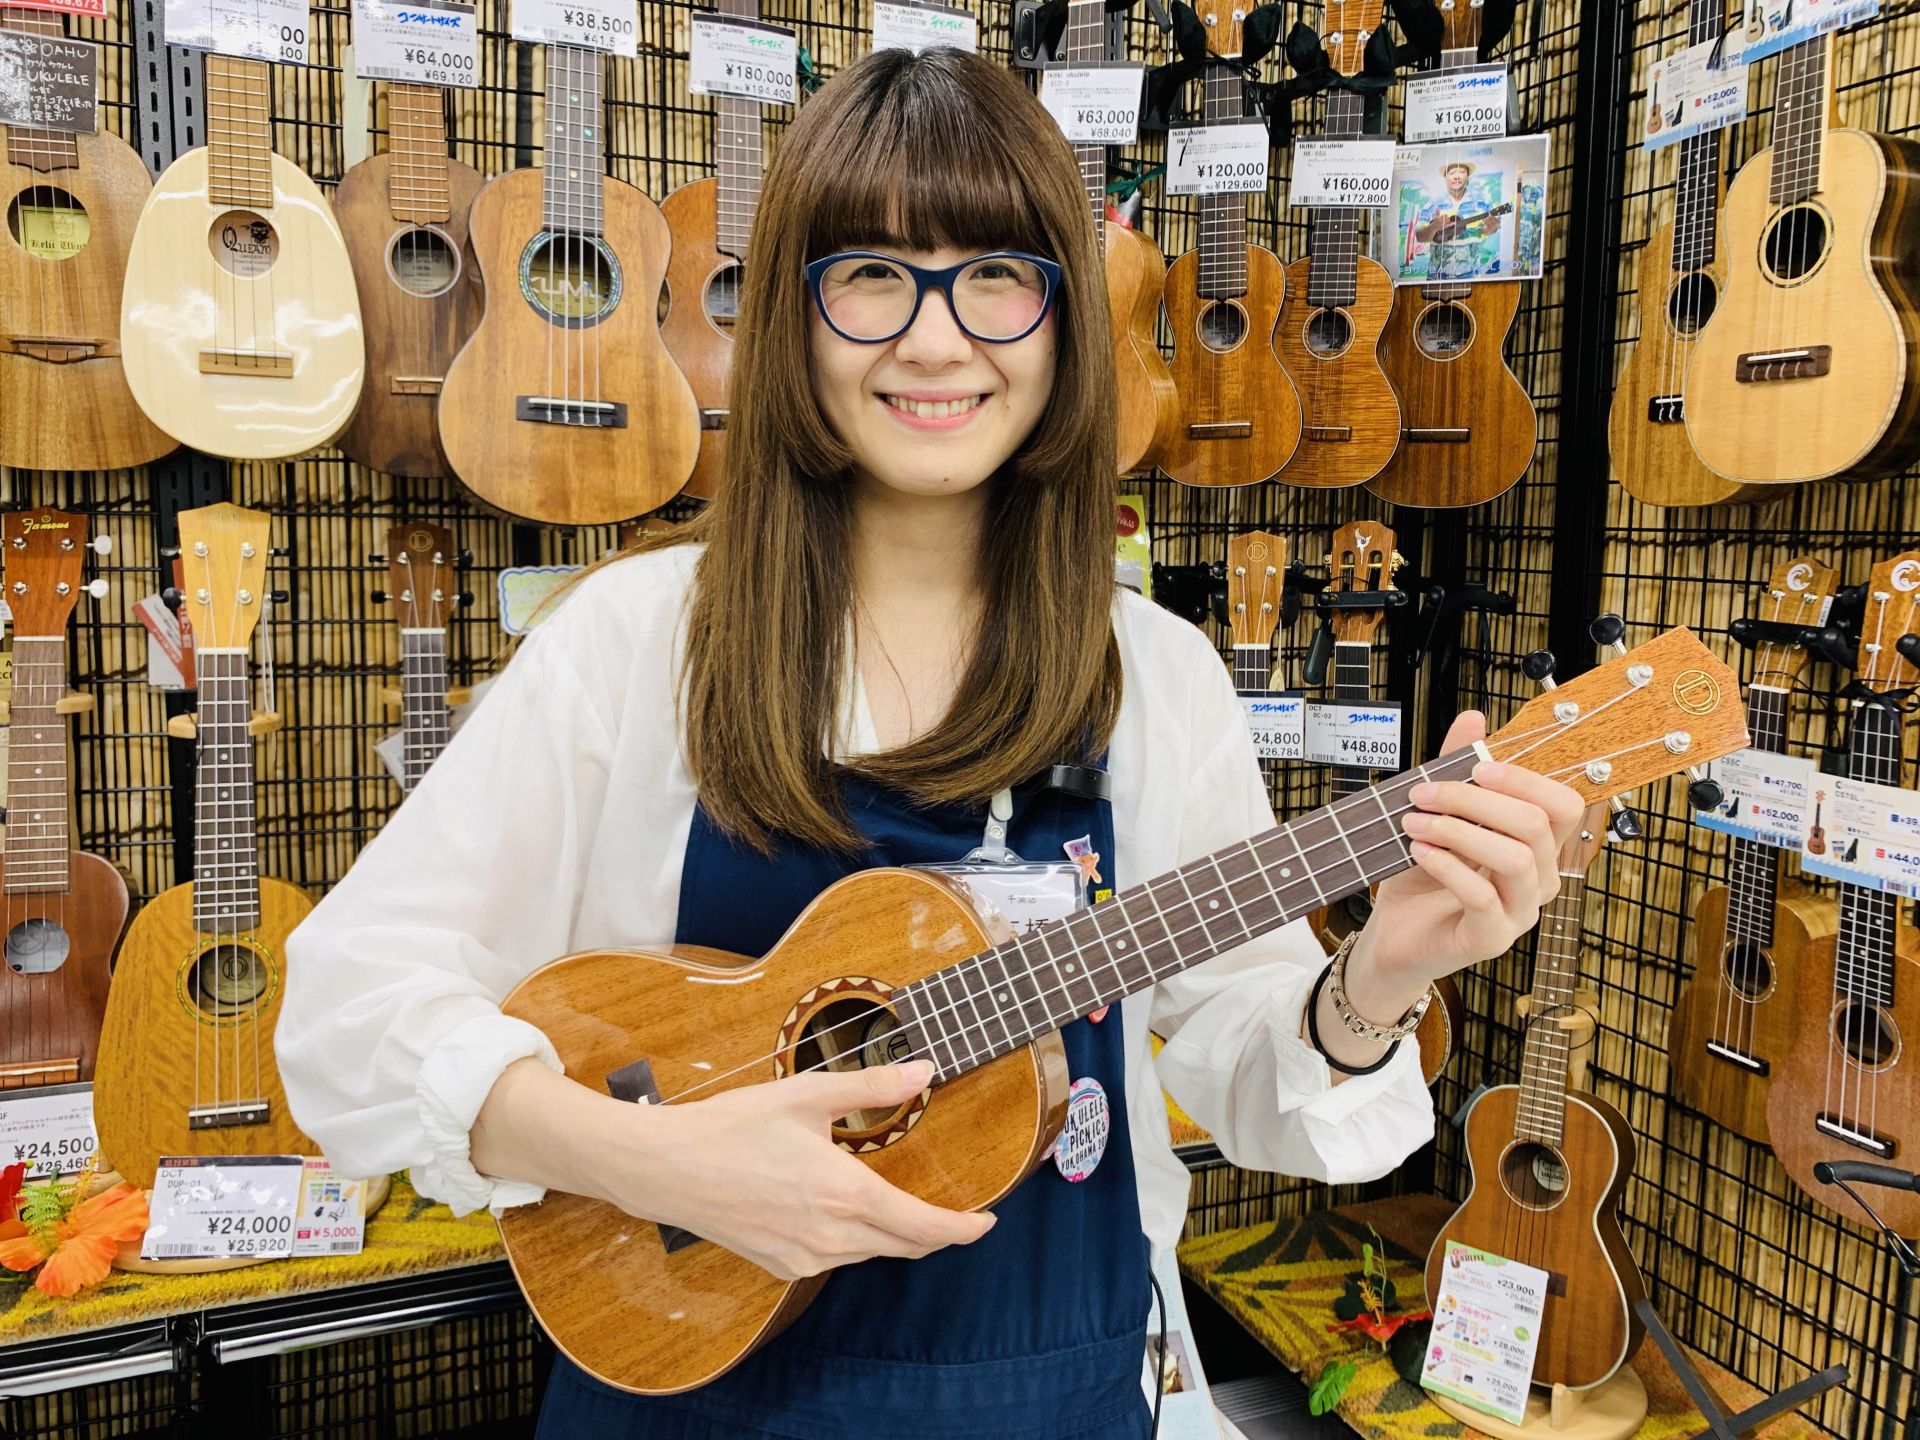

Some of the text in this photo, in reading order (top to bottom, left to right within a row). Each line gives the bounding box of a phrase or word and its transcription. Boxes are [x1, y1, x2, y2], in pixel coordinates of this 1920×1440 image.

[898, 8, 924, 16] ukulele
[564, 10, 632, 35] ¥38,500
[41, 43, 89, 58] OAHU
[405, 48, 474, 70] ¥64,000
[26, 70, 90, 86] UKULELE
[424, 69, 473, 85] ¥69,120
[726, 64, 793, 87] ¥180,000
[1429, 77, 1454, 86] ukulele
[745, 83, 792, 100] ¥194,400
[1077, 110, 1135, 125] ¥63,000
[1435, 107, 1502, 125] ¥160,000
[1091, 128, 1132, 138] ¥68,040
[1454, 123, 1501, 135] ¥172,800
[1197, 163, 1265, 178] ¥120,000
[1215, 180, 1262, 190] ¥129,600
[1322, 178, 1389, 191] ¥160,000
[1340, 194, 1386, 203] ¥172,800
[22, 518, 69, 534] Famous
[1253, 732, 1300, 745] 24,800
[1259, 747, 1299, 757] ¥26,784
[1342, 739, 1397, 754] ¥48,800
[1356, 755, 1395, 765] ¥52,704
[1762, 809, 1799, 822] ¥52,000
[1064, 1096, 1104, 1133] UKULELE
[14, 1136, 95, 1160] ¥24,500
[1061, 1144, 1097, 1172] YOKOHAMA
[161, 1169, 184, 1178] DCT
[208, 1216, 291, 1235] ¥24,000
[228, 1238, 287, 1252] ¥25,920
[1498, 1279, 1535, 1296] ¥23,900
